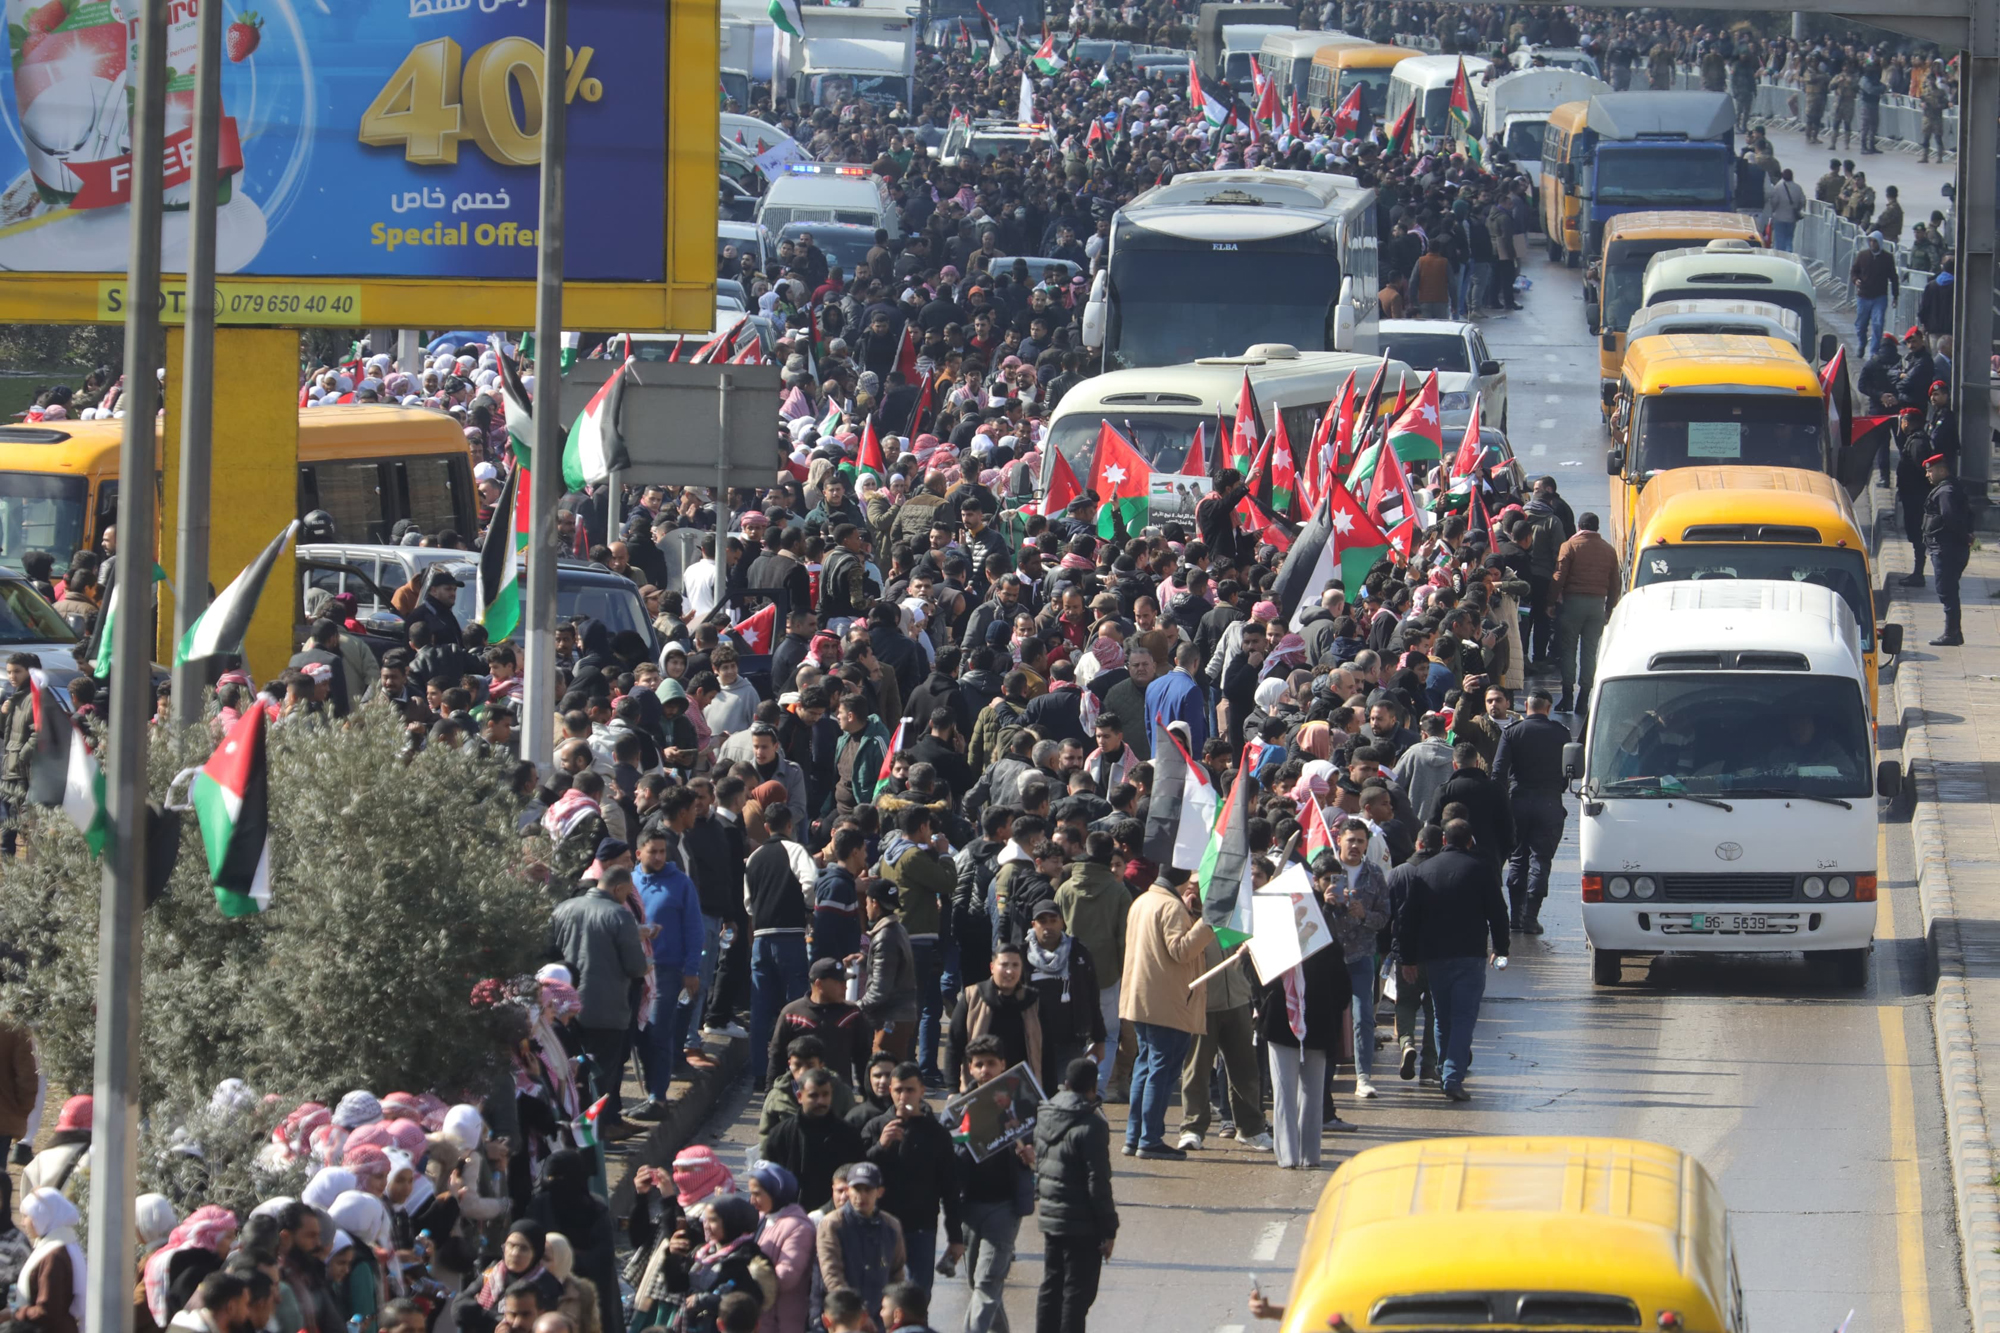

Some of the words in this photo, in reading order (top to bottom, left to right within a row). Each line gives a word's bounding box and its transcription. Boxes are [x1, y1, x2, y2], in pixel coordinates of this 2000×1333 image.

[110, 138, 194, 193] FEE
[391, 186, 446, 213] خاص
[452, 187, 511, 214] خصم
[370, 221, 468, 251] Special
[1212, 242, 1239, 251] ELBA
[231, 294, 263, 313] 079
[266, 295, 301, 313] 650
[304, 296, 327, 313] 40
[331, 296, 354, 313] 40
